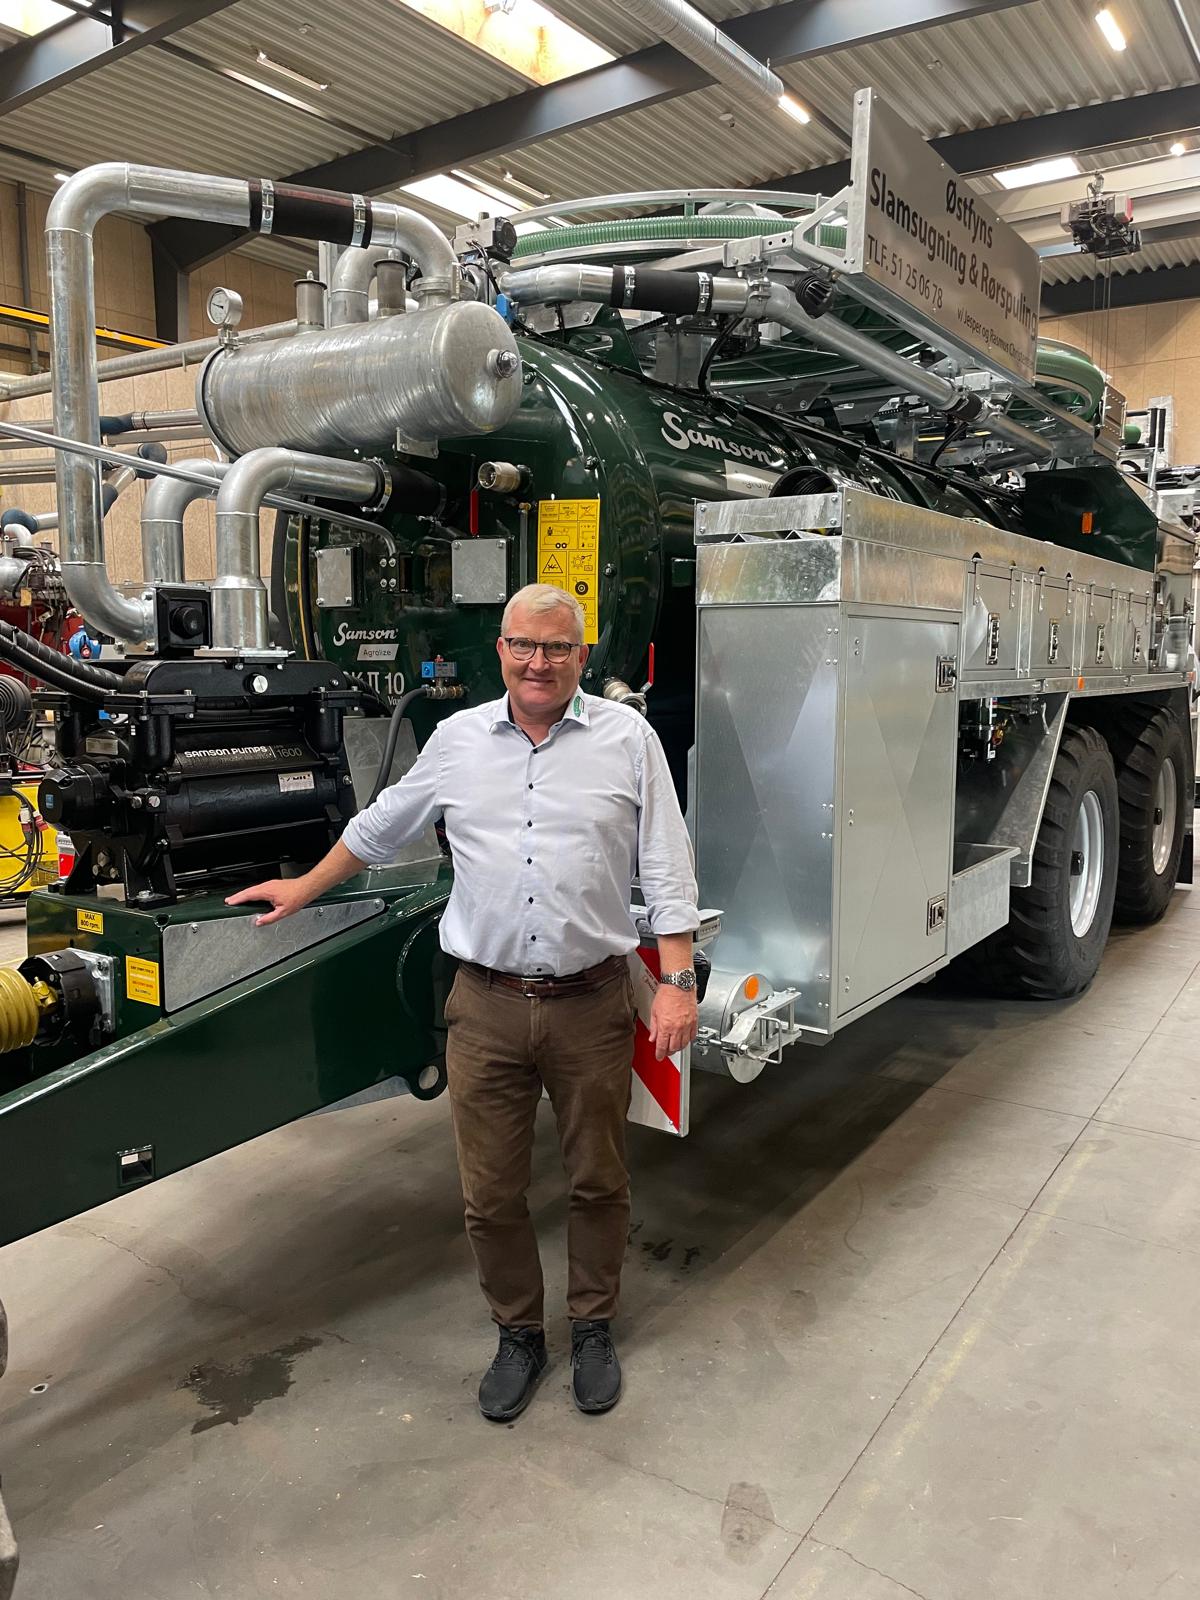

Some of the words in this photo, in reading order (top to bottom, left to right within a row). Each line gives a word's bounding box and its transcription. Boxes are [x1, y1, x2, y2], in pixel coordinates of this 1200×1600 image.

[945, 179, 993, 249] Østfyns
[869, 167, 966, 286] Slamsugning
[968, 252, 979, 288] &
[980, 261, 1038, 341] Rørspuling
[867, 234, 889, 272] TLF.
[890, 252, 903, 281] 51
[905, 263, 918, 291] 25
[919, 273, 930, 300] 06
[932, 283, 943, 309] 78
[964, 310, 981, 334] Jesper
[982, 327, 989, 343] og
[661, 411, 780, 467] Samson
[333, 622, 398, 646] Samson
[384, 671, 405, 695] 10
[184, 749, 229, 758] SAMSON
[231, 745, 268, 755] PUMPS
[277, 747, 302, 758] 1600
[84, 913, 95, 921] MAX
